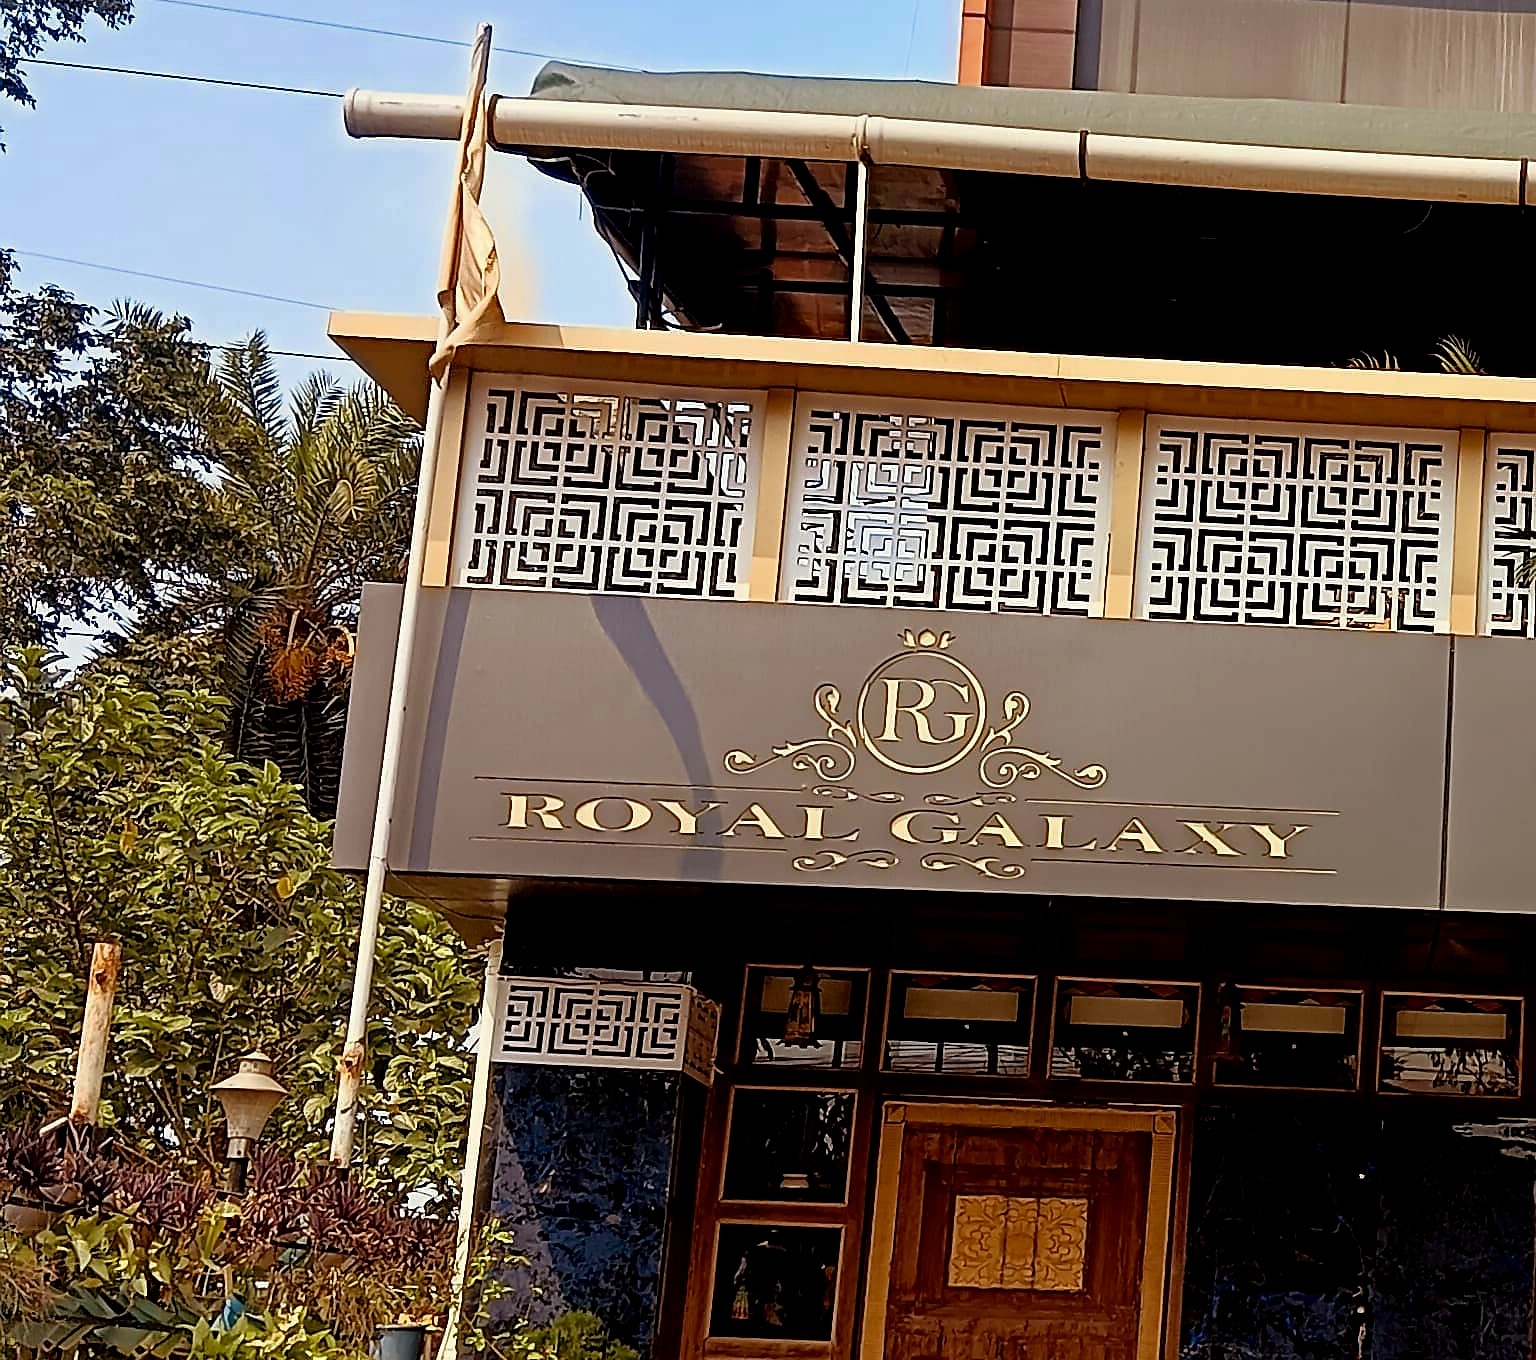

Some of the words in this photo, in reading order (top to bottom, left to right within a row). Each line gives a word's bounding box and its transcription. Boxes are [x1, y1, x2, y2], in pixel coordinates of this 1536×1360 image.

[876, 678, 975, 744] RG
[501, 791, 860, 844] ROYAL
[891, 809, 1313, 860] GALAXY
